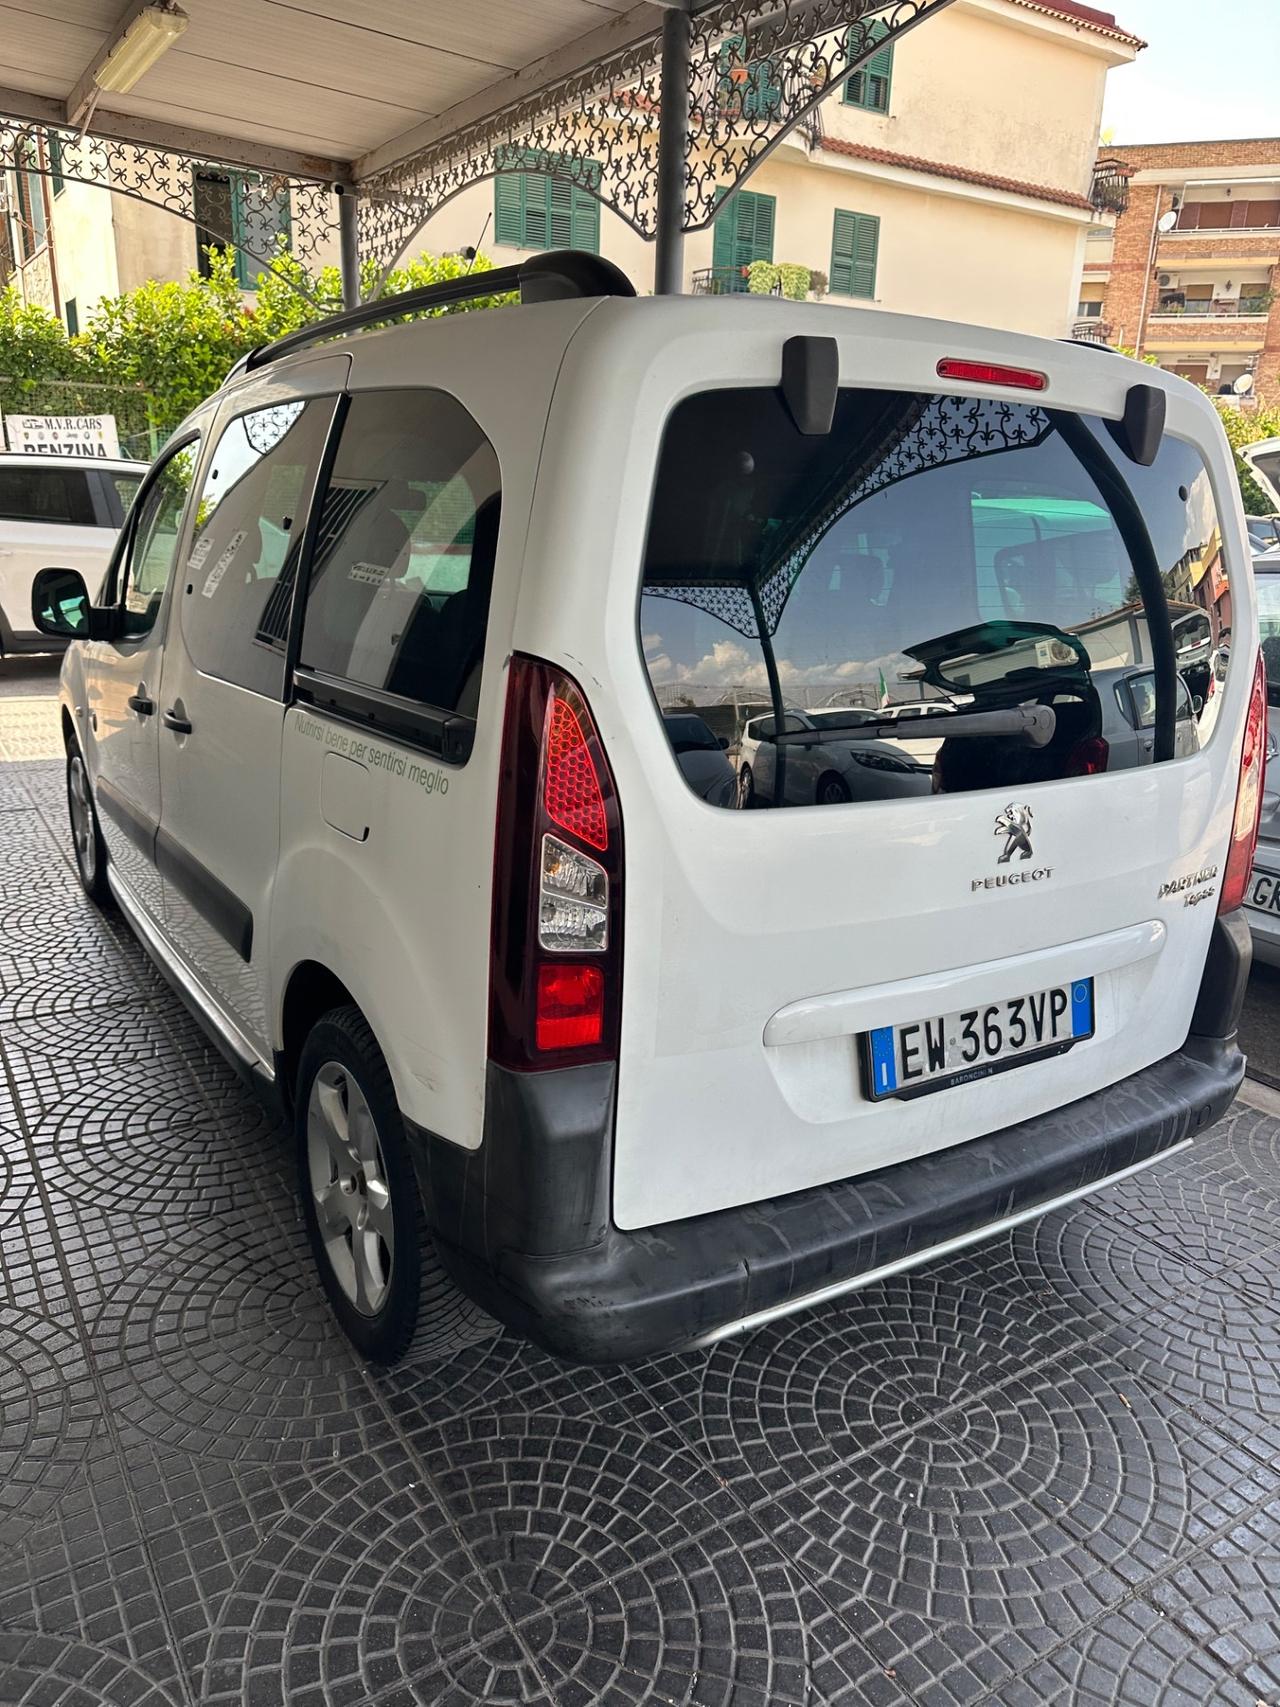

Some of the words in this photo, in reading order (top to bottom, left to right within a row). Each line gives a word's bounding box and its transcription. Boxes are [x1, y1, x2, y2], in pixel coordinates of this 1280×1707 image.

[295, 714, 325, 741] Nutrisi
[325, 725, 349, 751] bene
[350, 740, 368, 760] per
[368, 747, 408, 776] sentirsi
[408, 763, 449, 795] meglio
[971, 867, 1055, 891] PEUGEOT
[1158, 865, 1218, 899] PARTNER
[901, 1017, 946, 1080] EW
[960, 988, 1068, 1062] 363VP
